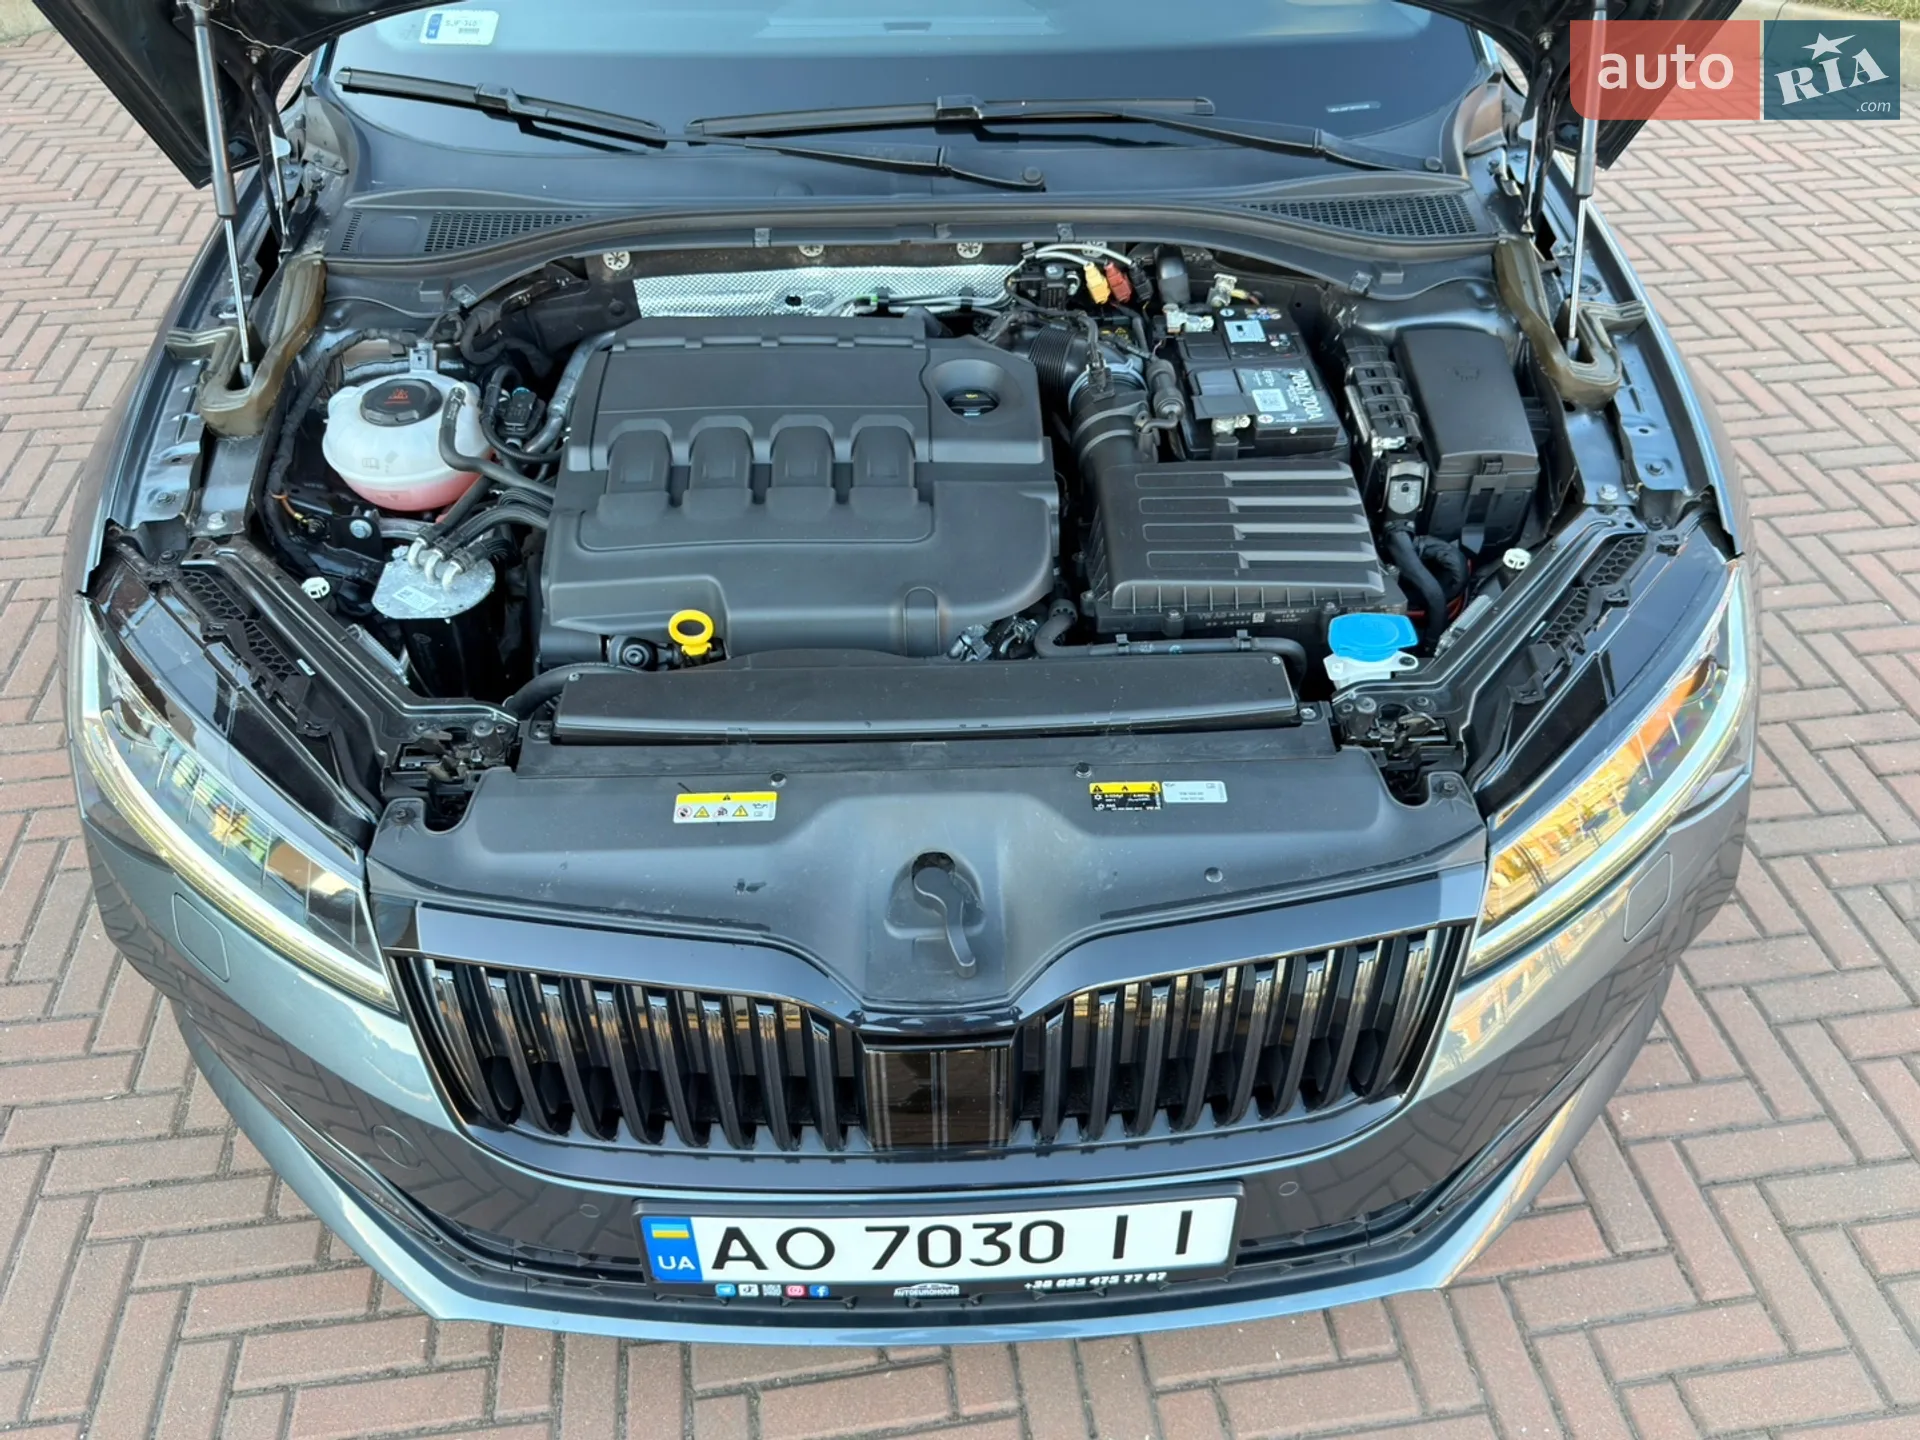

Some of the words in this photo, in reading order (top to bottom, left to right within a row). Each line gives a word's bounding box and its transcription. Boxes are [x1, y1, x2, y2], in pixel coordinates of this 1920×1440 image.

[1289, 369, 1315, 395] 70Ah
[1299, 394, 1325, 421] 700A
[711, 1226, 836, 1271] AO
[864, 1219, 1065, 1271] 7030
[657, 1255, 696, 1271] UA
[1024, 1279, 1053, 1290] +38
[1123, 1273, 1144, 1284] 77
